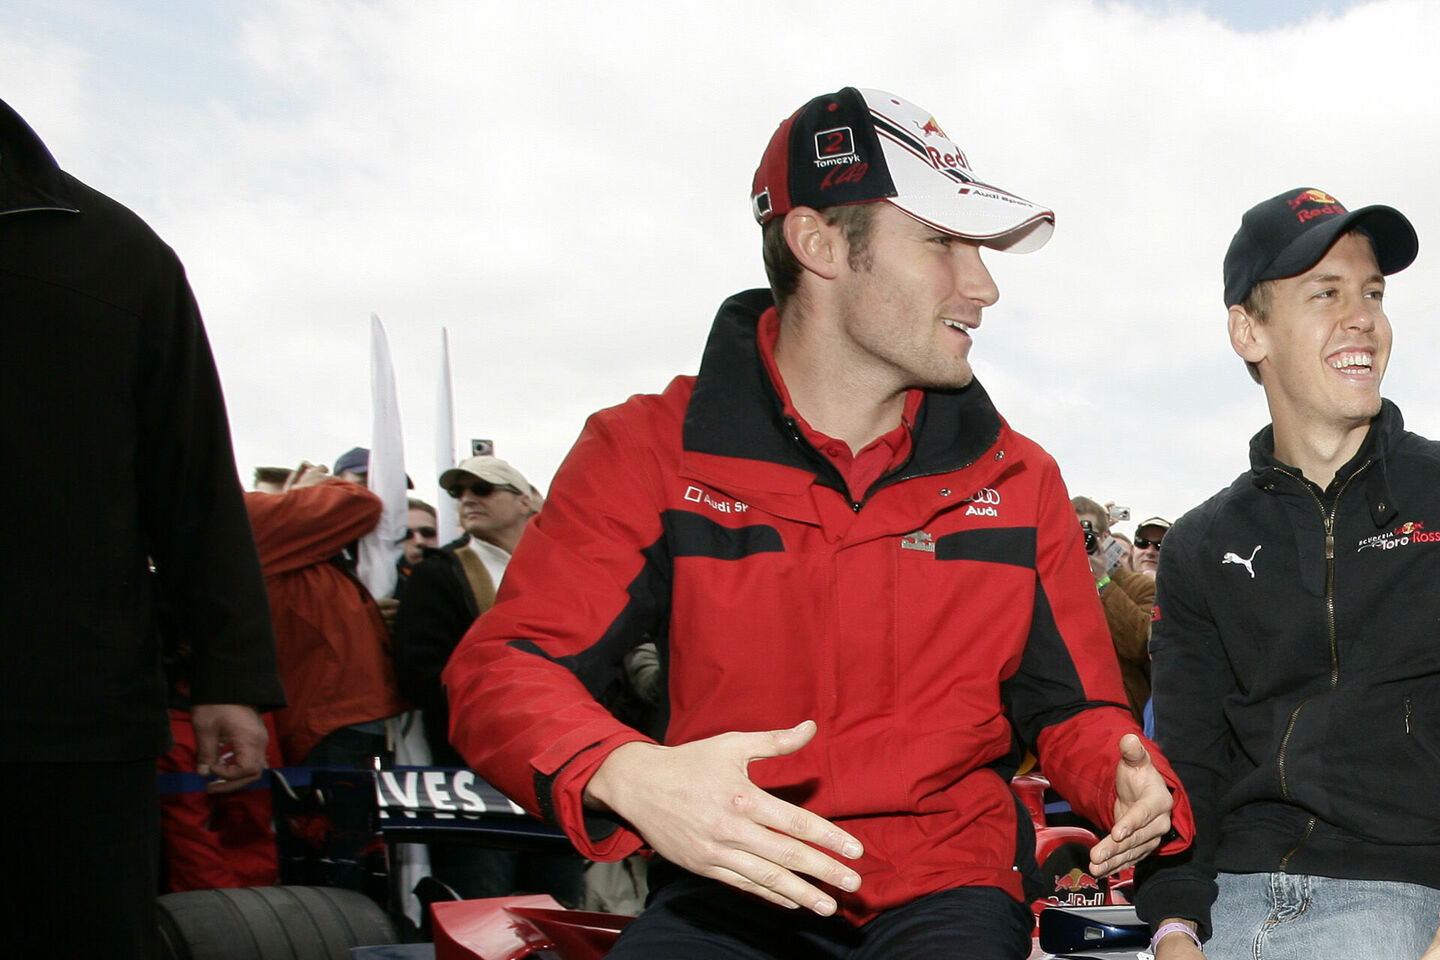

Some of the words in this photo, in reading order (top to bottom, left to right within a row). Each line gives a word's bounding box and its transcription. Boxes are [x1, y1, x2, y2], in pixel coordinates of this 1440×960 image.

[824, 131, 844, 152] 2
[813, 153, 861, 168] Tomczyk
[926, 146, 967, 171] Red
[1296, 204, 1335, 224] Red
[703, 493, 731, 513] Audi
[965, 504, 998, 517] Audi
[1378, 536, 1409, 550] Toro
